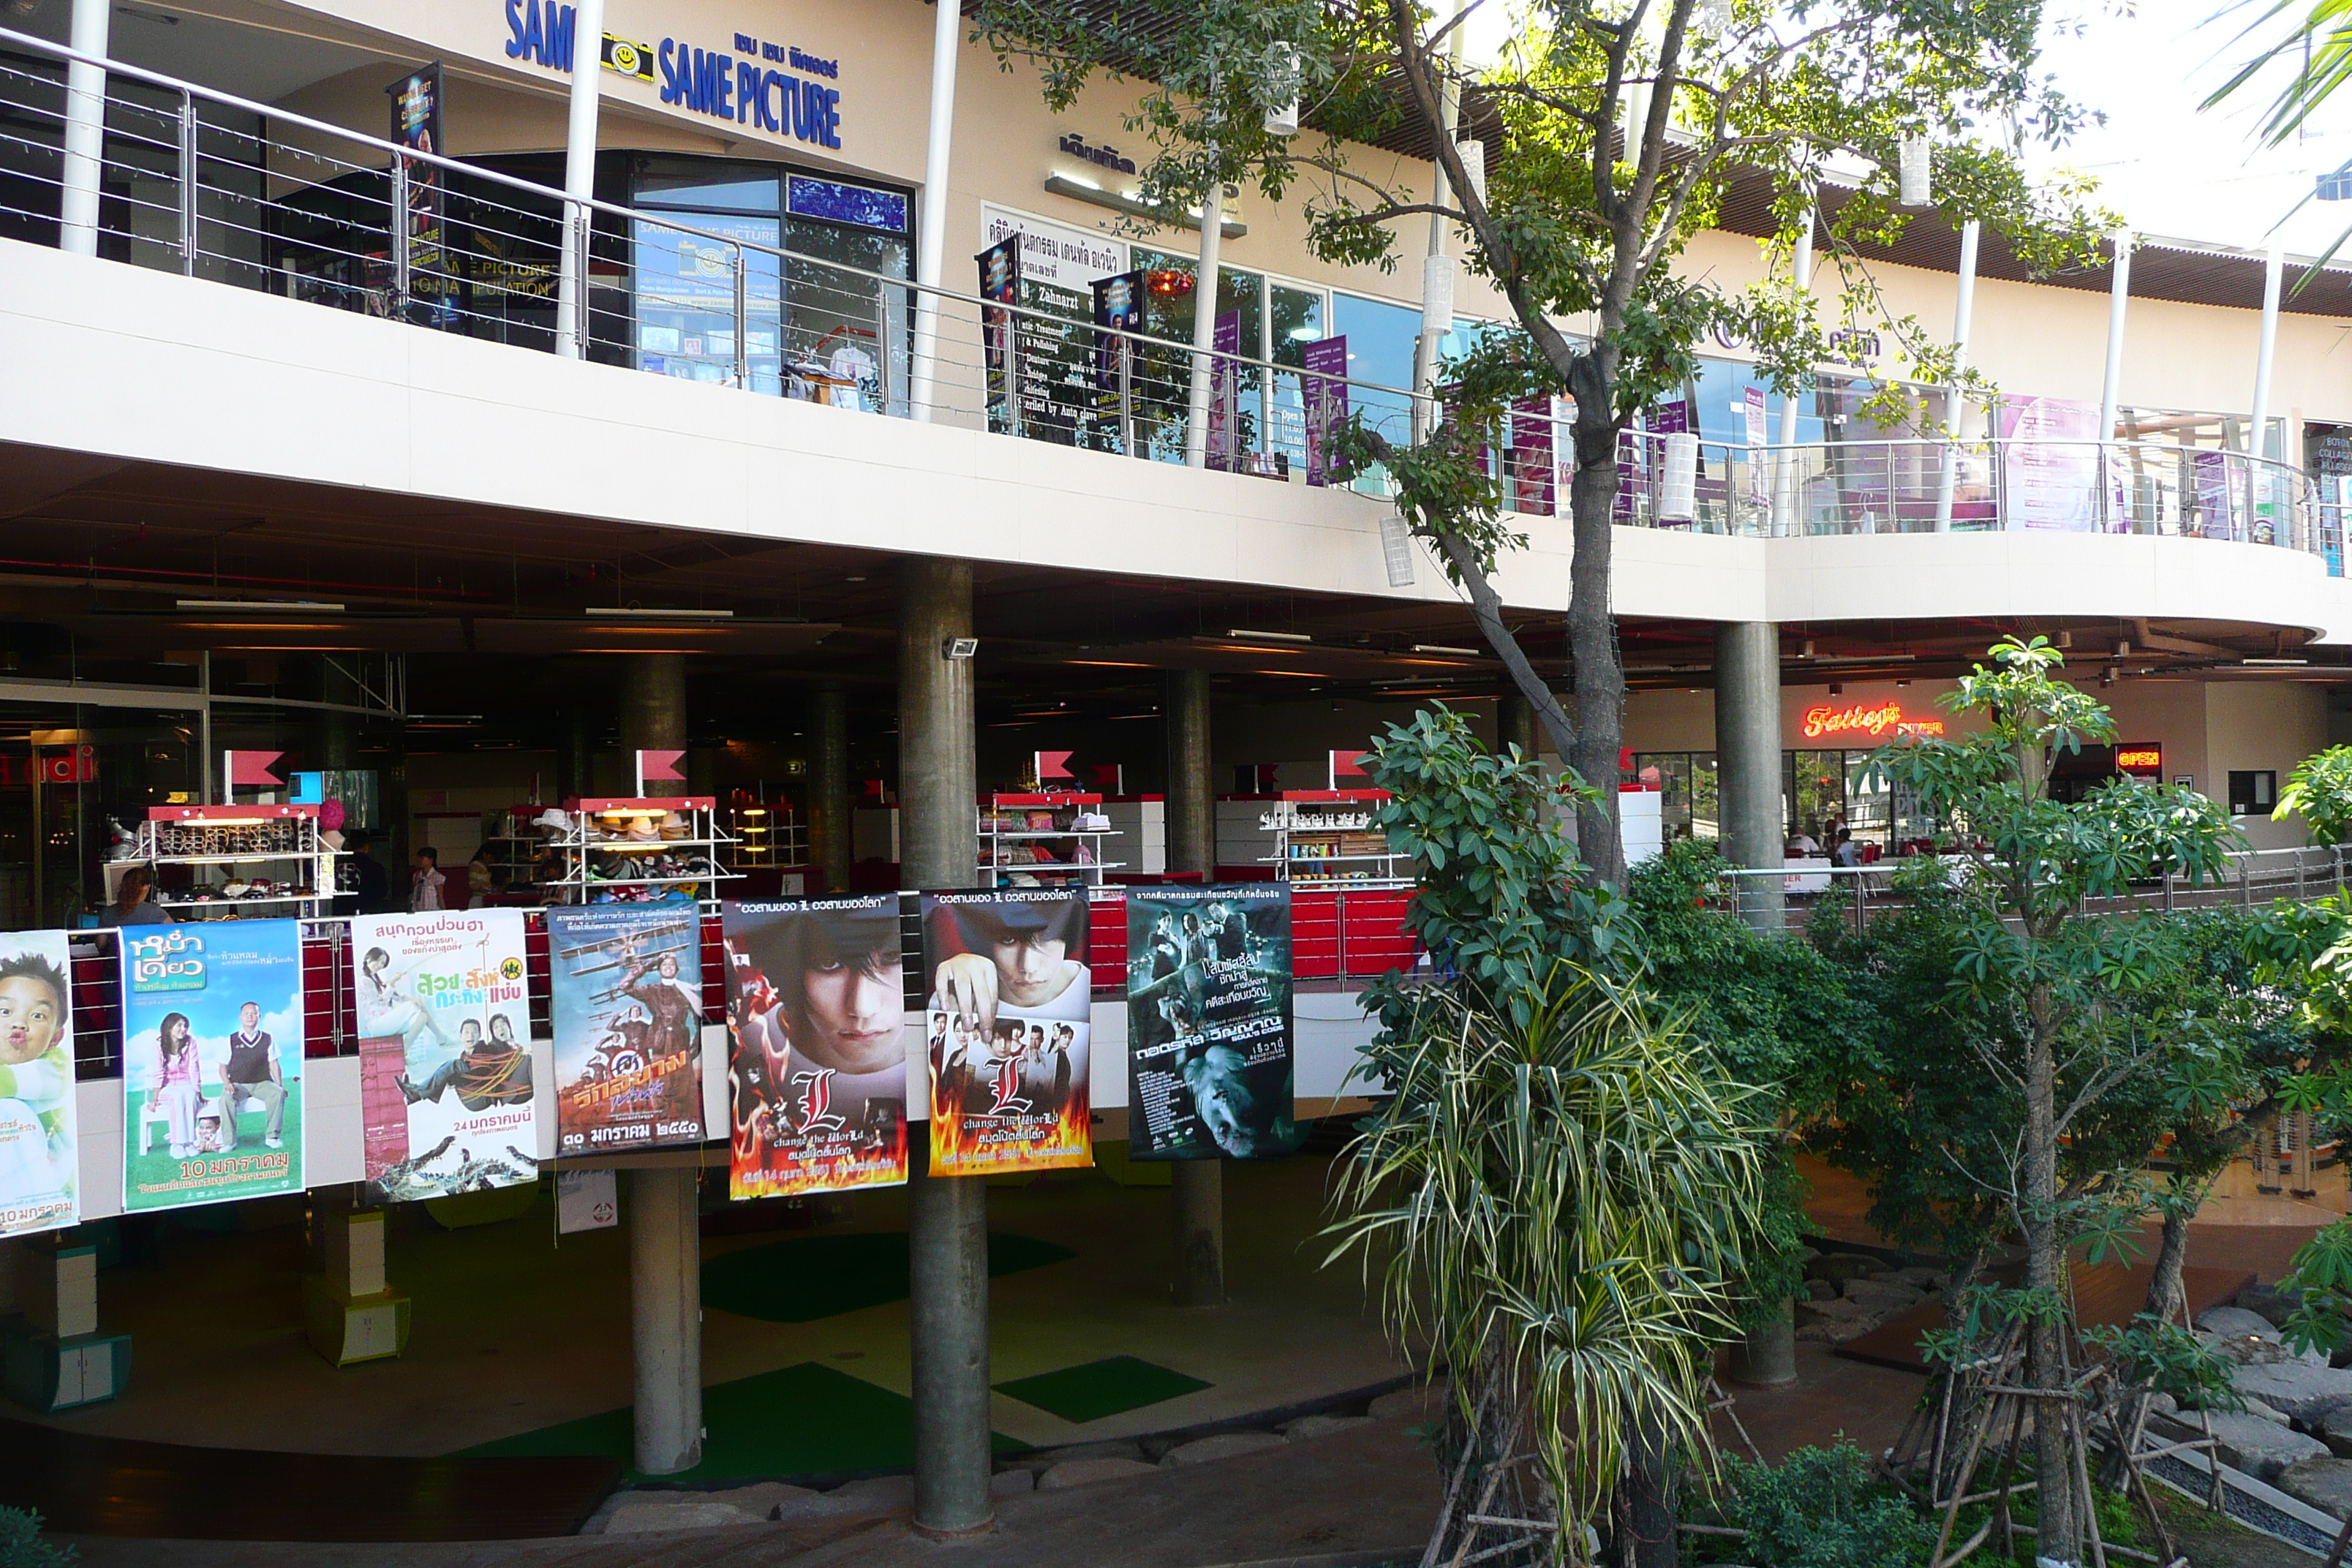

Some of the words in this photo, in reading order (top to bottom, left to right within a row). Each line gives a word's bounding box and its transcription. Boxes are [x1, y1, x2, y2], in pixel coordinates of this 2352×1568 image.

[505, 0, 576, 72] SAM
[659, 37, 734, 119] SAME
[737, 61, 841, 149] PICTURE
[723, 228, 777, 242] PICTURE
[483, 262, 550, 276] PICTURE
[436, 281, 549, 296] MAIPULATION
[1039, 285, 1079, 310] Zahnarzt
[1033, 338, 1059, 354] Polishing
[1049, 403, 1058, 416] by
[1060, 407, 1078, 418] Auto
[1079, 411, 1097, 422] clave
[1282, 409, 1298, 422] Open
[1284, 434, 1303, 446] 10.00
[1804, 702, 1901, 736] Fatboy's
[2118, 752, 2160, 766] OPEN
[1262, 1024, 1284, 1035] CODE
[983, 1055, 1033, 1115] L
[791, 1068, 846, 1135] L
[453, 1121, 467, 1132] 24
[963, 1119, 998, 1130] change
[1002, 1117, 1018, 1126] the
[591, 1123, 650, 1142] มกราคม
[774, 1135, 807, 1147] change
[810, 1133, 826, 1144] the
[181, 1161, 206, 1180] 10
[210, 1152, 289, 1174] มกราคม
[20, 1202, 72, 1219] มกราคม
